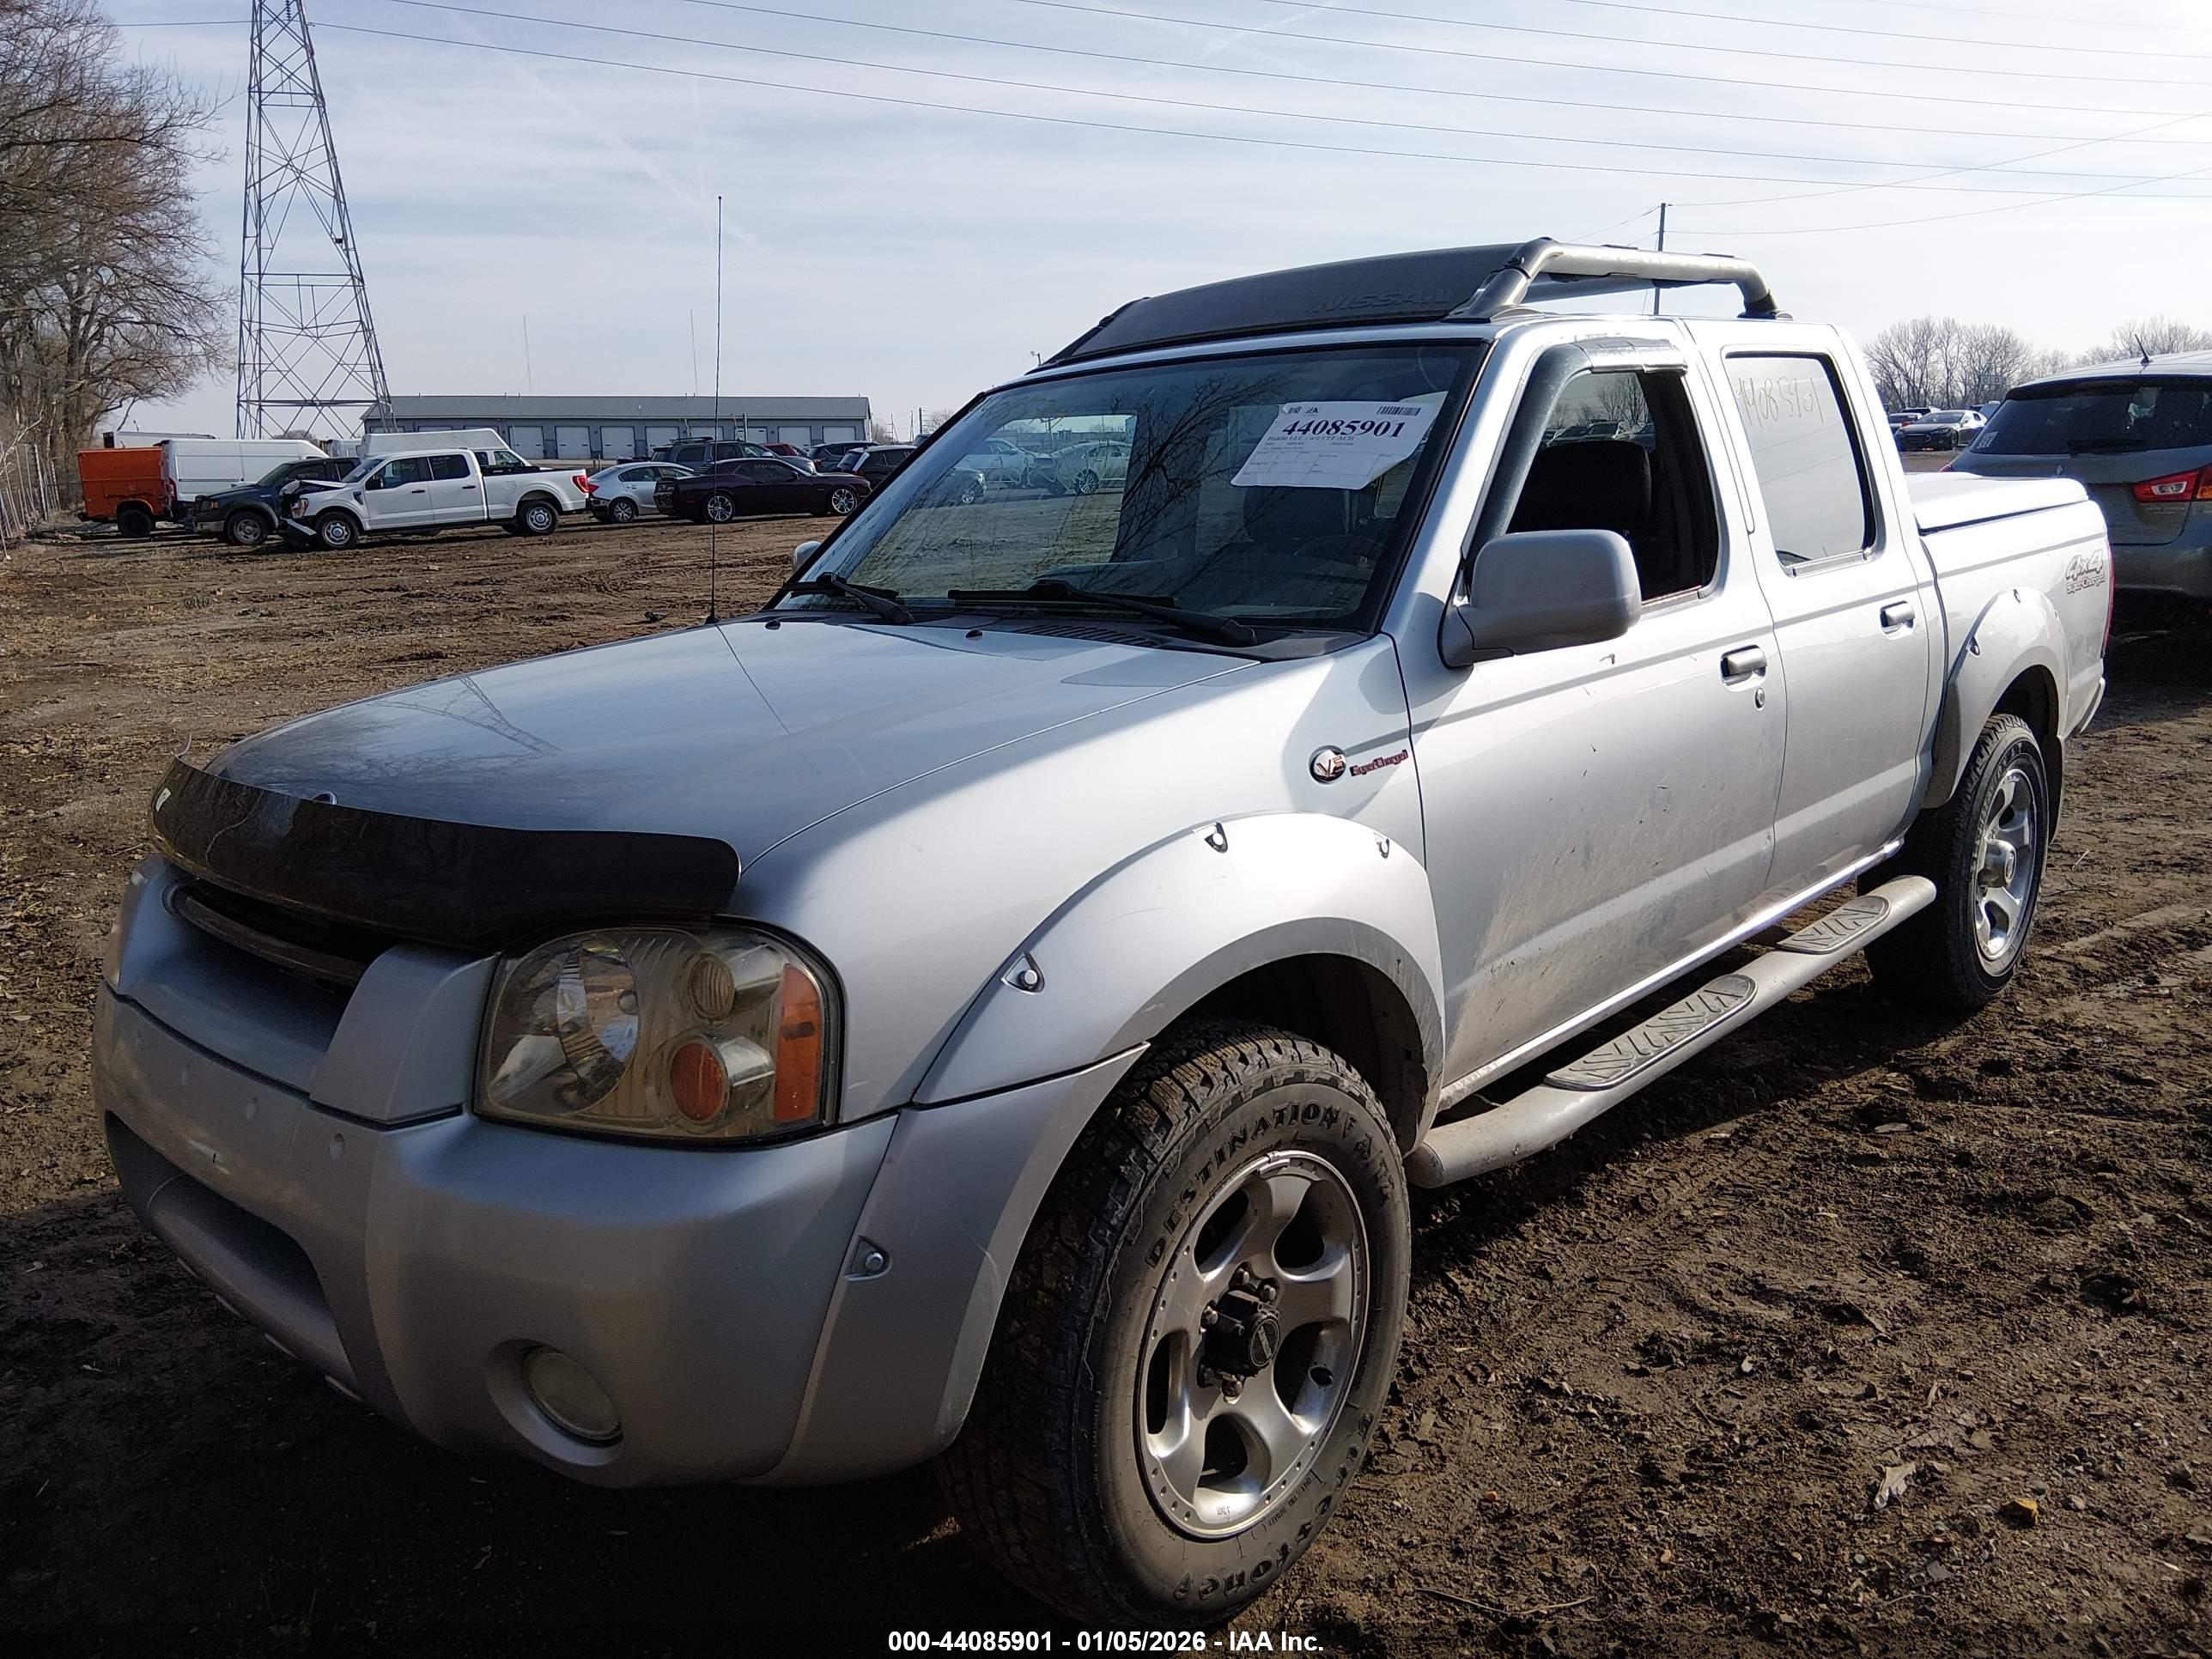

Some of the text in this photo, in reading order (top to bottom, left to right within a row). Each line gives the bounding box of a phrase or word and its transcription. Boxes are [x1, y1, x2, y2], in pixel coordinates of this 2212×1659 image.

[1310, 290, 1451, 313] NISSAN
[1282, 419, 1406, 438] 44085901
[1145, 1100, 1340, 1268] DESTINATION
